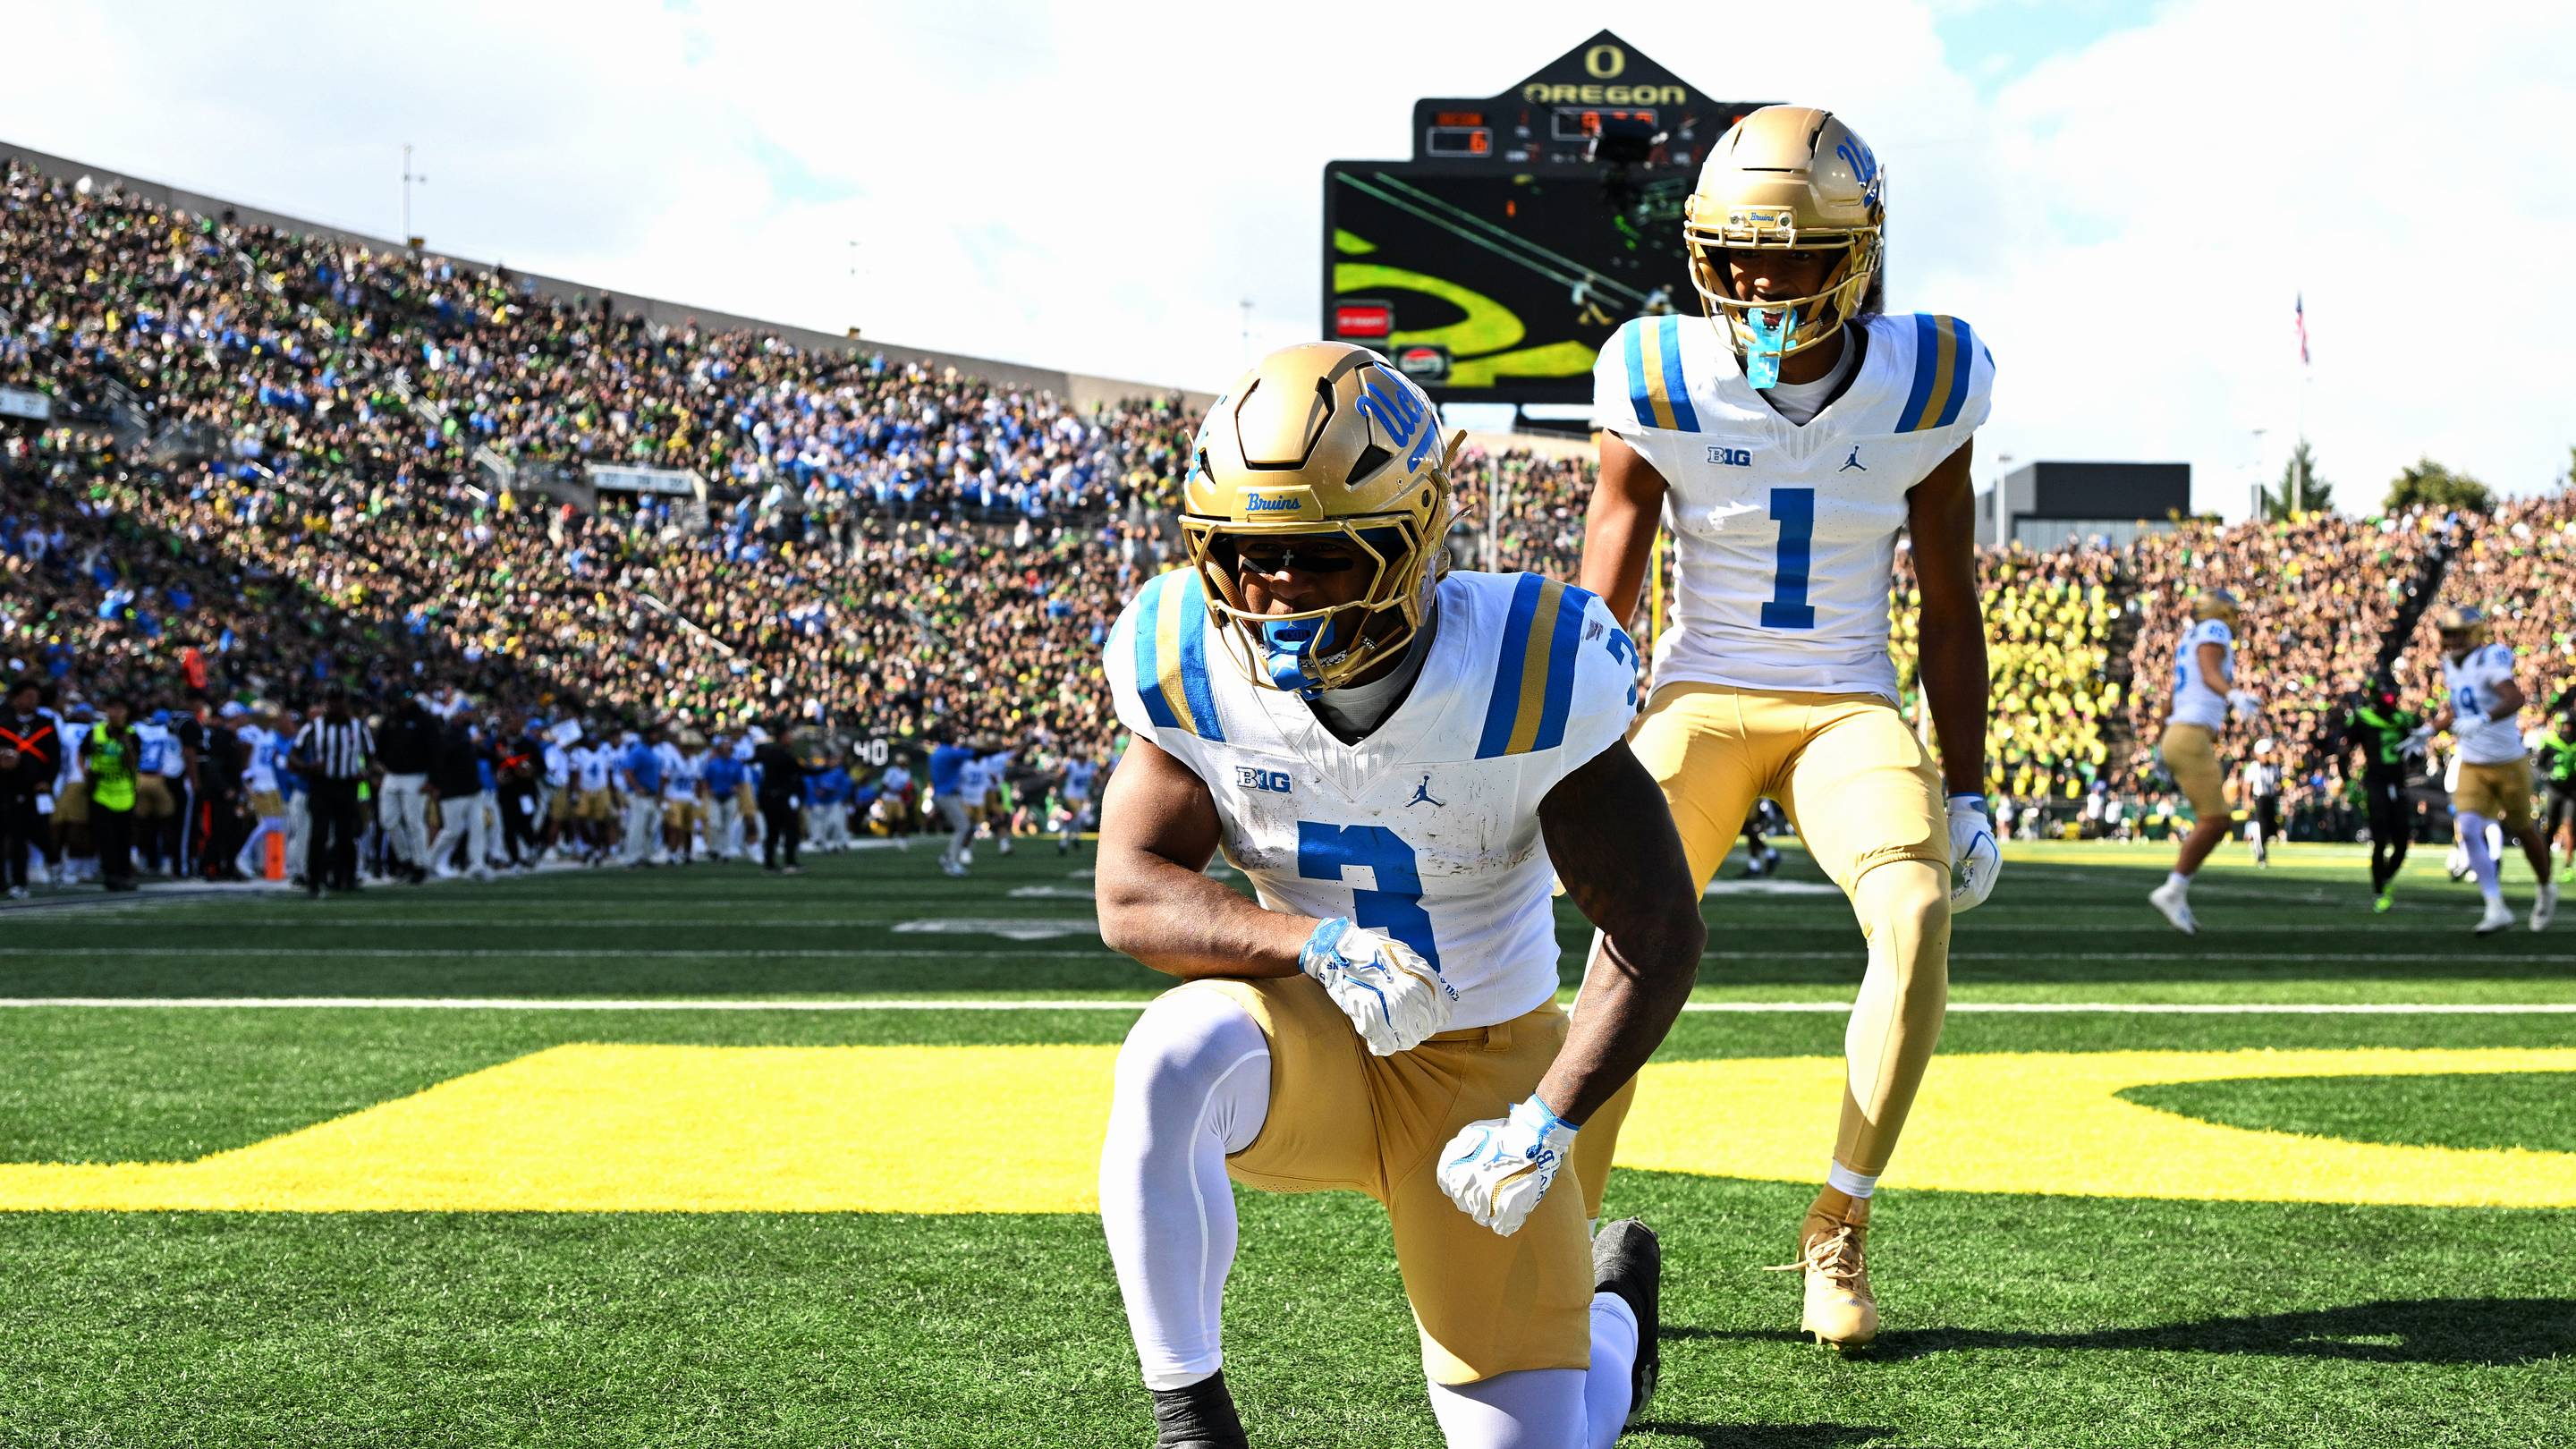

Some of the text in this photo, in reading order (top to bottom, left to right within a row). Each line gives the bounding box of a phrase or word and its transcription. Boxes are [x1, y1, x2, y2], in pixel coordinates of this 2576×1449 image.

[1585, 45, 1625, 79] O
[1524, 83, 1686, 105] OREGON
[1470, 131, 1487, 154] 6
[1246, 492, 1301, 512] Bruins
[1760, 487, 1816, 629] 1
[853, 738, 889, 767] 40
[1297, 820, 1441, 974] 3
